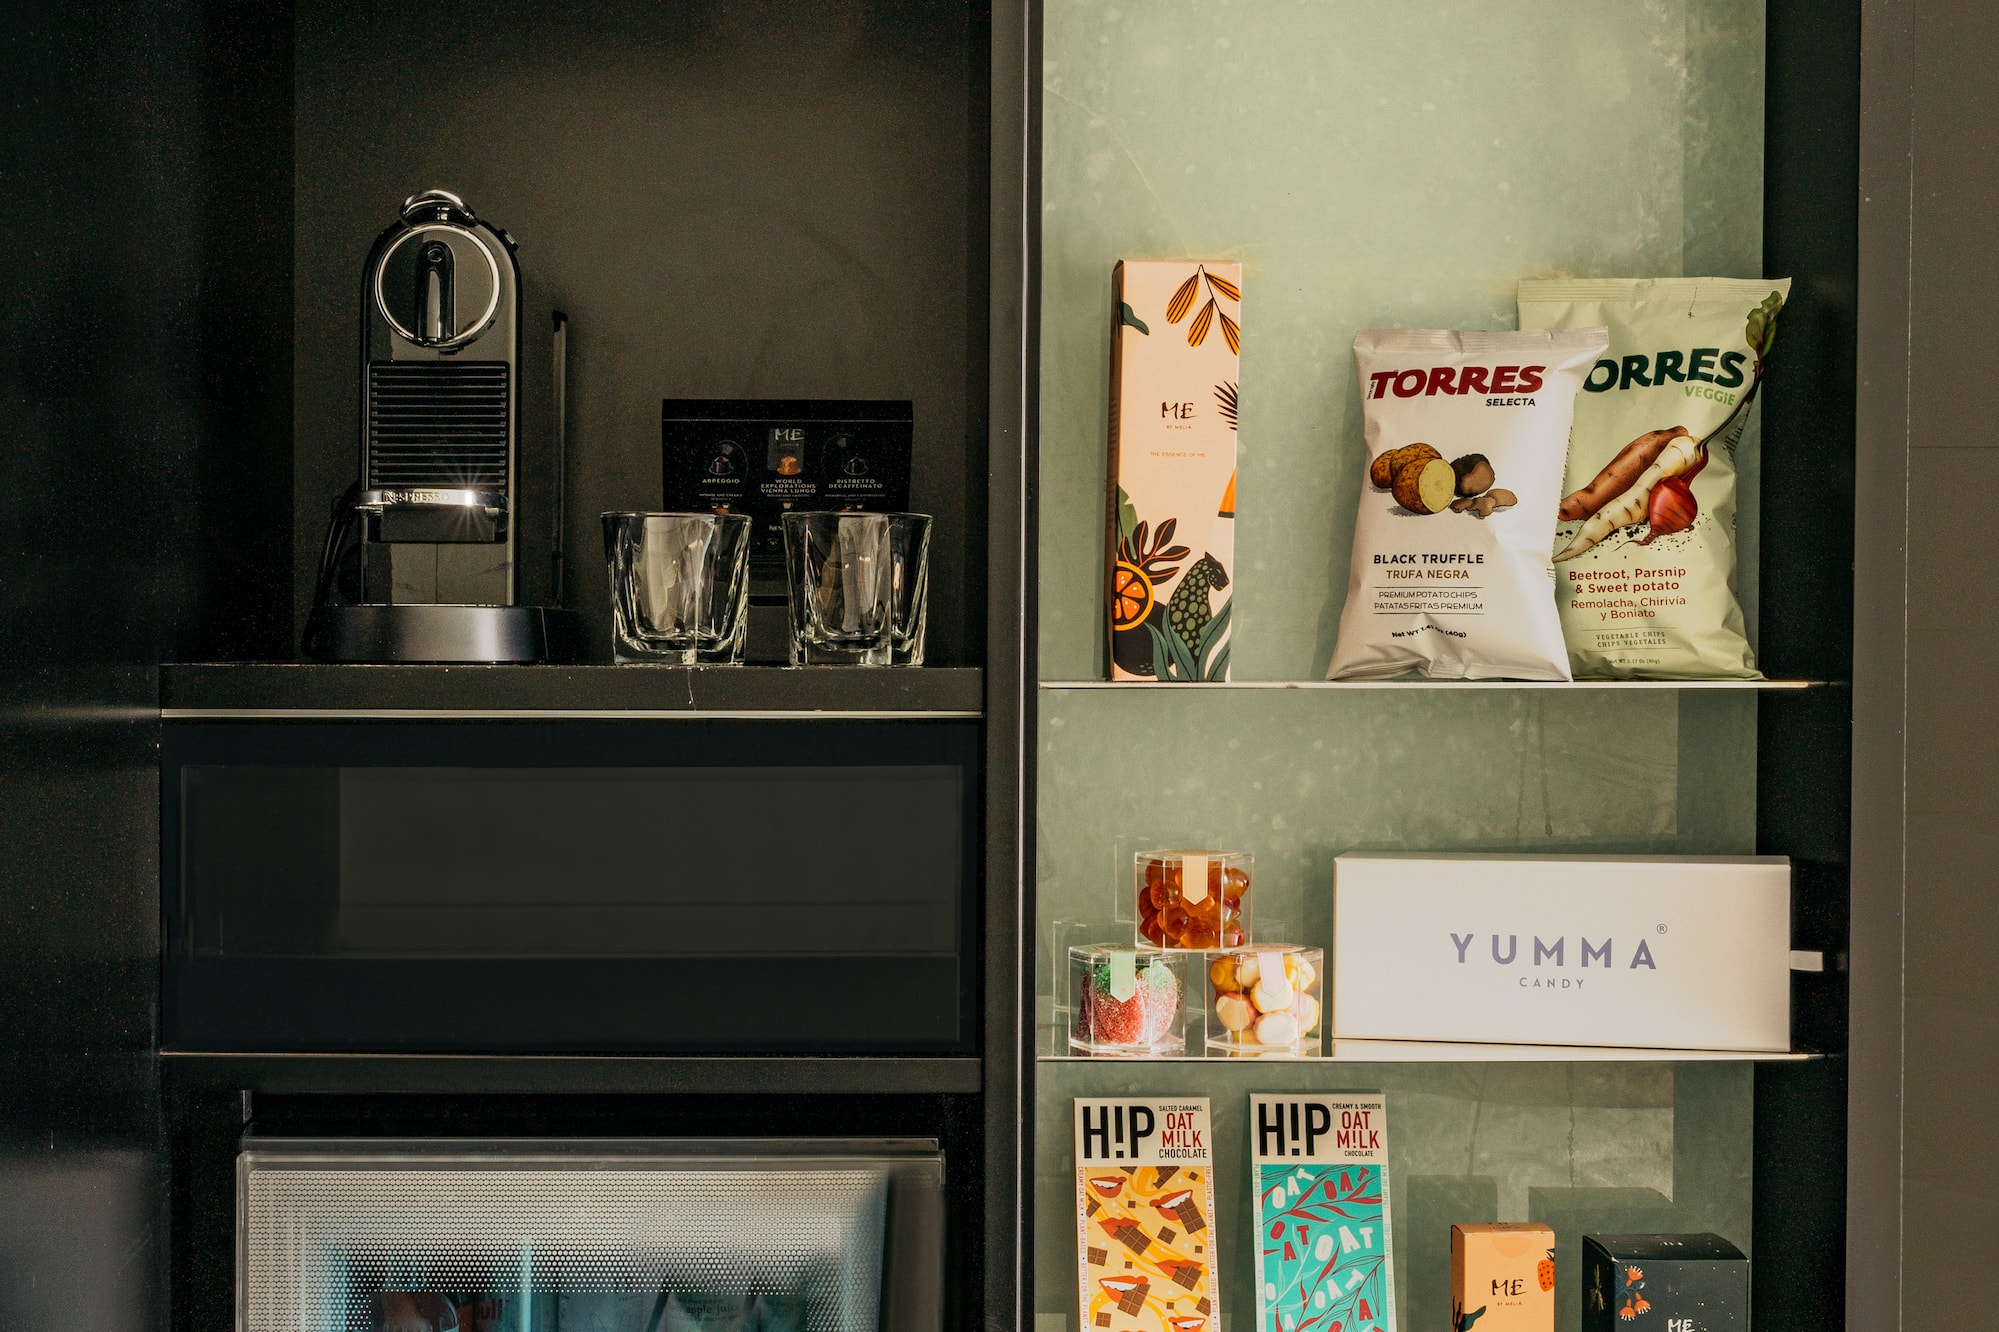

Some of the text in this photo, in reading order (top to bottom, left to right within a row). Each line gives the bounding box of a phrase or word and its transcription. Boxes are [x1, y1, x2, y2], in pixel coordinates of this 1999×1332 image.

[1583, 348, 1747, 393] ORRES
[1370, 366, 1547, 399] TORRES
[1162, 402, 1198, 420] ME
[1486, 398, 1536, 407] SELECTA
[775, 429, 804, 441] ME
[1374, 554, 1484, 564] BLACK TRUFFLE
[1386, 570, 1470, 579] TRUFA NEGRA
[1570, 567, 1686, 580] Beetroot, Parsnip
[1576, 581, 1680, 594] & Sweet potato
[1572, 596, 1686, 609] Remolacha, Chirivía
[1601, 609, 1656, 621] y Boniato
[1596, 632, 1639, 640] VEGETABLE
[1450, 934, 1657, 970] YUMMA
[1520, 978, 1584, 989] CANDY
[1167, 1113, 1194, 1130] OAT
[1342, 1111, 1371, 1130] OAT
[1083, 1106, 1155, 1159] H!P
[1258, 1103, 1331, 1156] H!P
[1162, 1131, 1203, 1148] M!LK
[1337, 1130, 1380, 1149] M!LK
[1159, 1149, 1207, 1159] CHOCOLATE
[1272, 1168, 1315, 1209] OAT
[1324, 1167, 1370, 1200] OAT
[1315, 1226, 1373, 1261] OAT
[1315, 1269, 1364, 1309] OAT
[1492, 1279, 1528, 1297] ME
[687, 1304, 712, 1314] apple
[1668, 1319, 1696, 1332] ME
